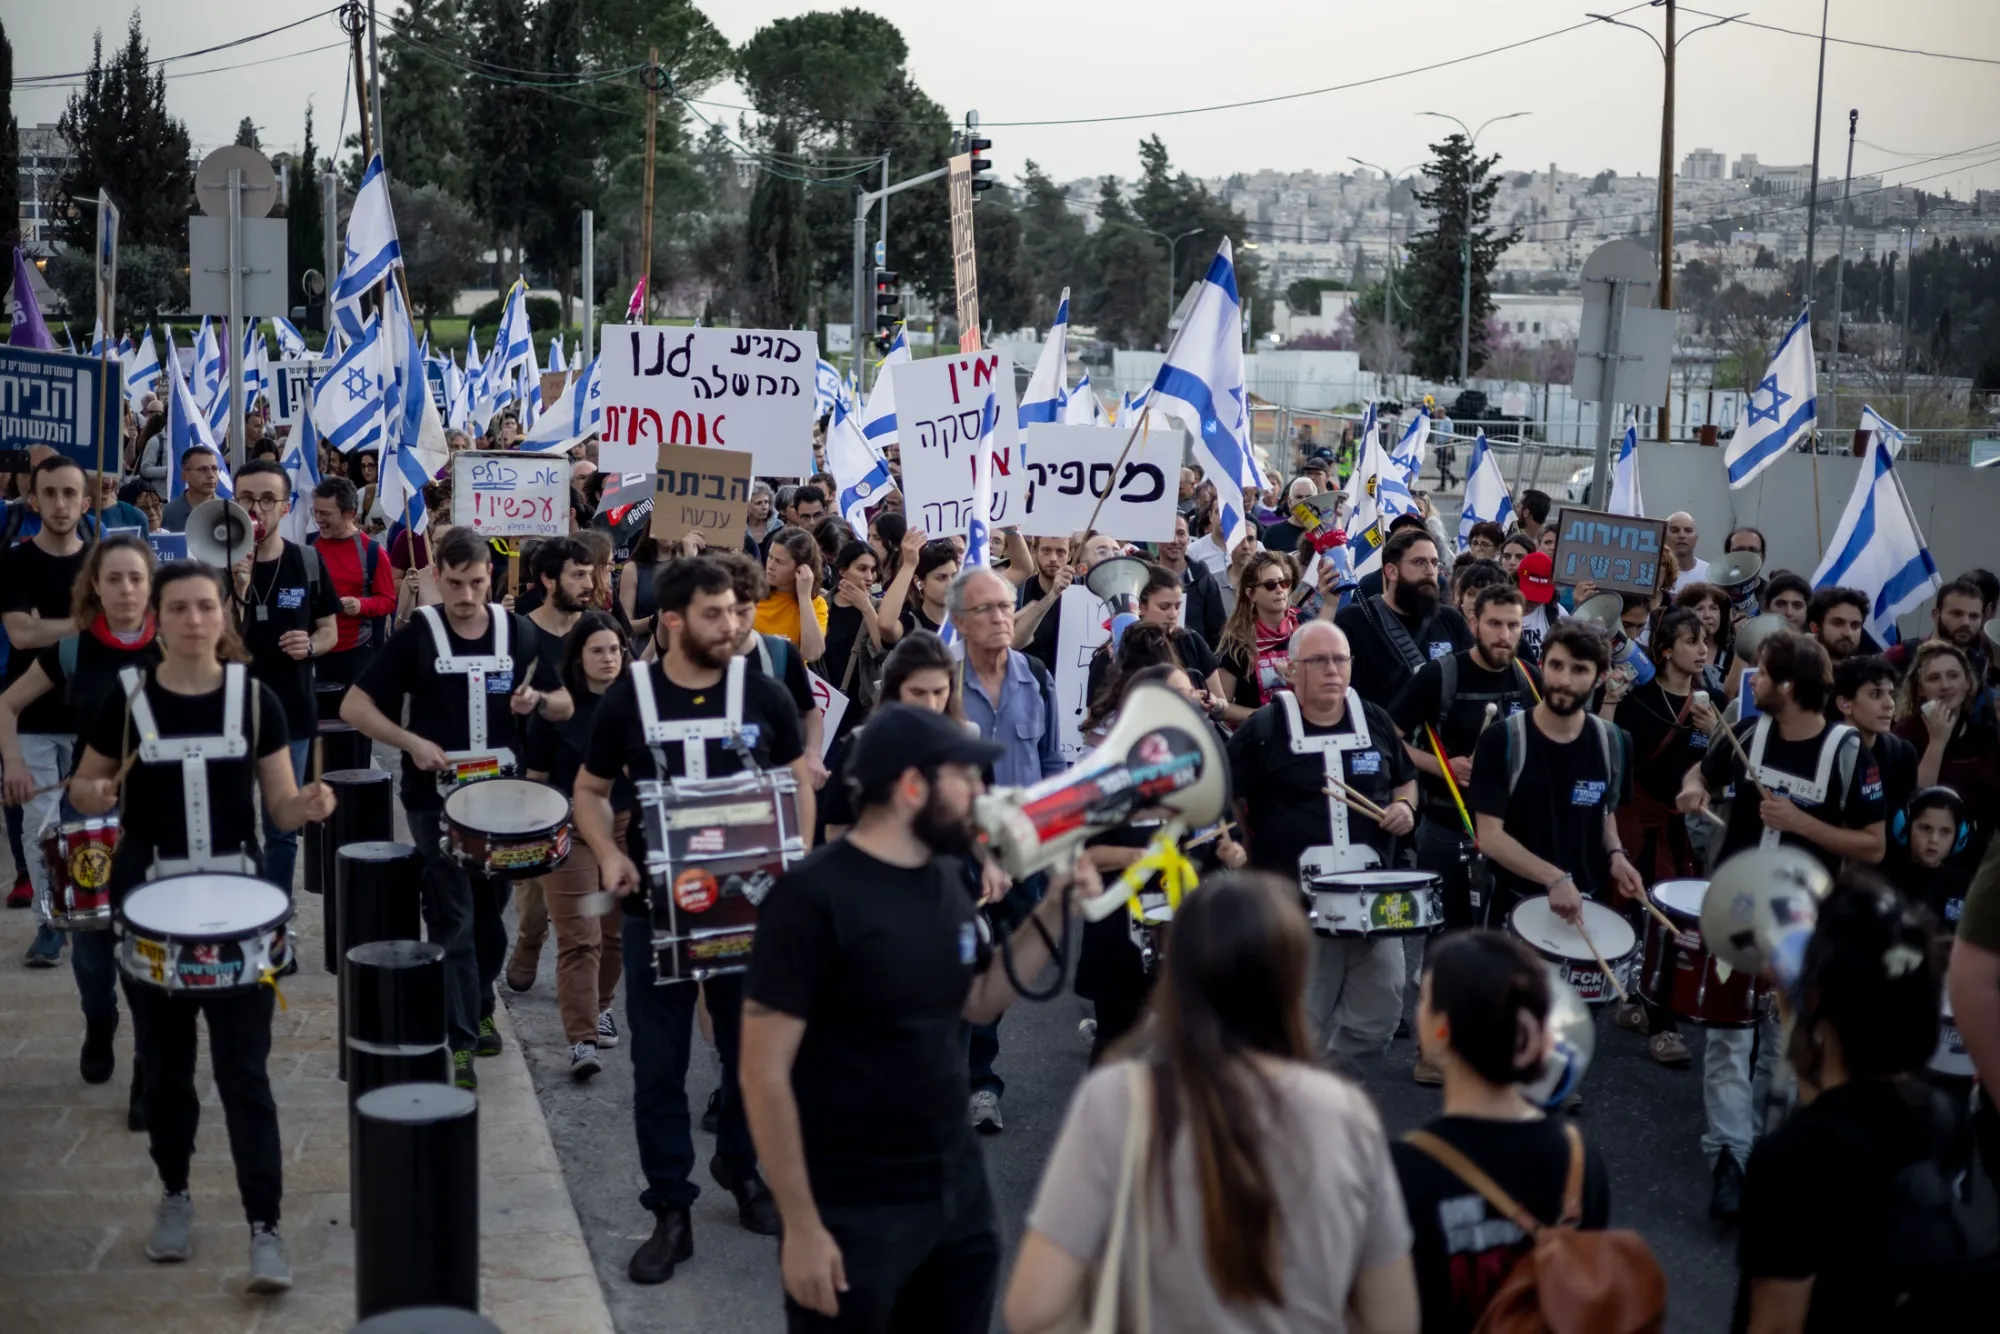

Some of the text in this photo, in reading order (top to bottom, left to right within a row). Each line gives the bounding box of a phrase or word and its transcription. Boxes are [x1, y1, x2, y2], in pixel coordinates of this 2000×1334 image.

[631, 331, 801, 377] מגיע לנו
[948, 355, 999, 405] אין
[472, 460, 559, 485] את כולם
[656, 468, 749, 503] הביתה
[970, 447, 1010, 490] אן
[1025, 461, 1165, 514] מספיק
[473, 492, 553, 526] עכשיו!
[681, 506, 731, 529] עכשיו
[1564, 520, 1658, 554] בחירות
[1564, 552, 1656, 586] עכשיו
[1570, 971, 1603, 985] FCK
